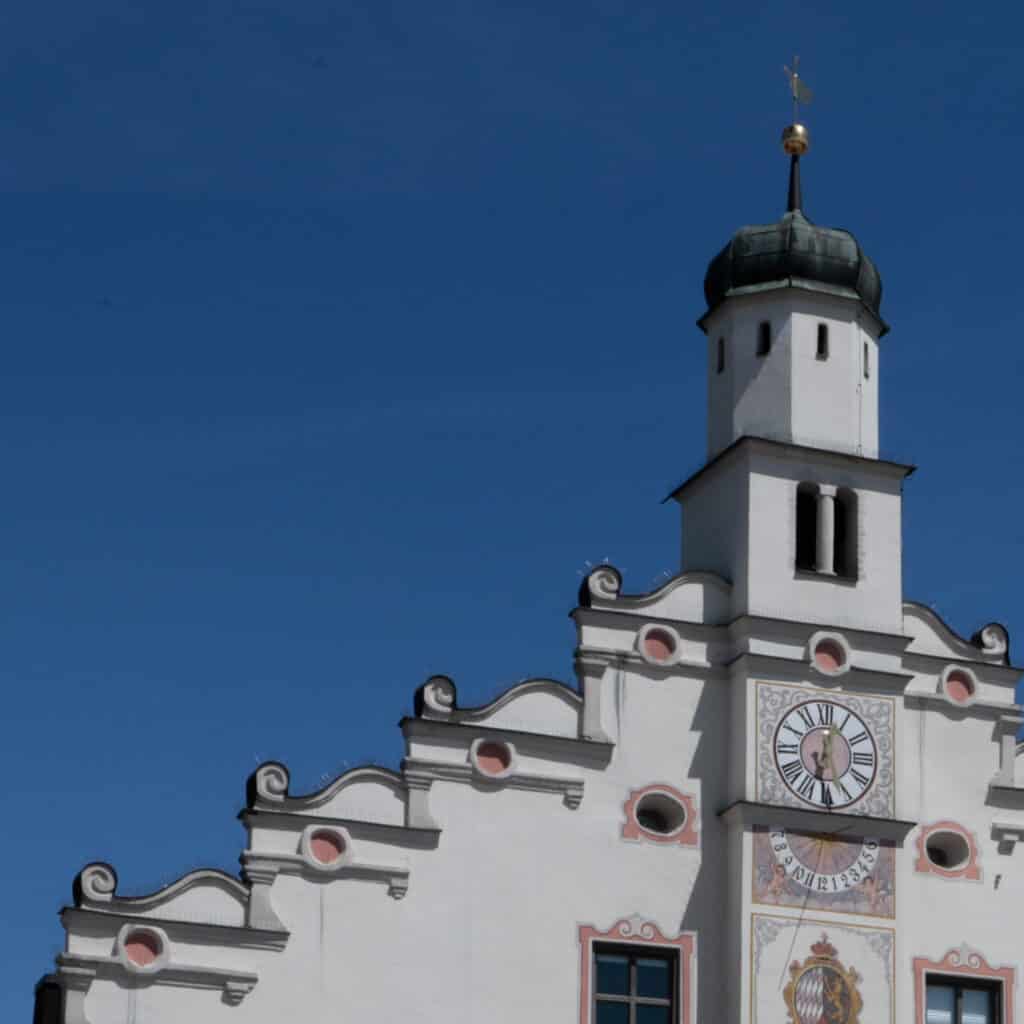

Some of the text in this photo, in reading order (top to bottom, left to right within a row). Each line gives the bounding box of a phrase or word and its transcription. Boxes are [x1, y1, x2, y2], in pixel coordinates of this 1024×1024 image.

[797, 706, 815, 729] XI
[817, 703, 834, 725] XII
[849, 731, 868, 746] II
[778, 743, 798, 754] IX
[853, 751, 873, 766] III
[781, 760, 803, 784] VIII
[797, 774, 815, 801] VII
[774, 842, 787, 852] 8
[862, 851, 874, 863] 5
[792, 866, 805, 880] 10
[804, 872, 815, 887] 11
[848, 868, 861, 882] 3
[817, 877, 828, 890] 12
[832, 877, 838, 890] 1
[840, 874, 851, 888] 2
